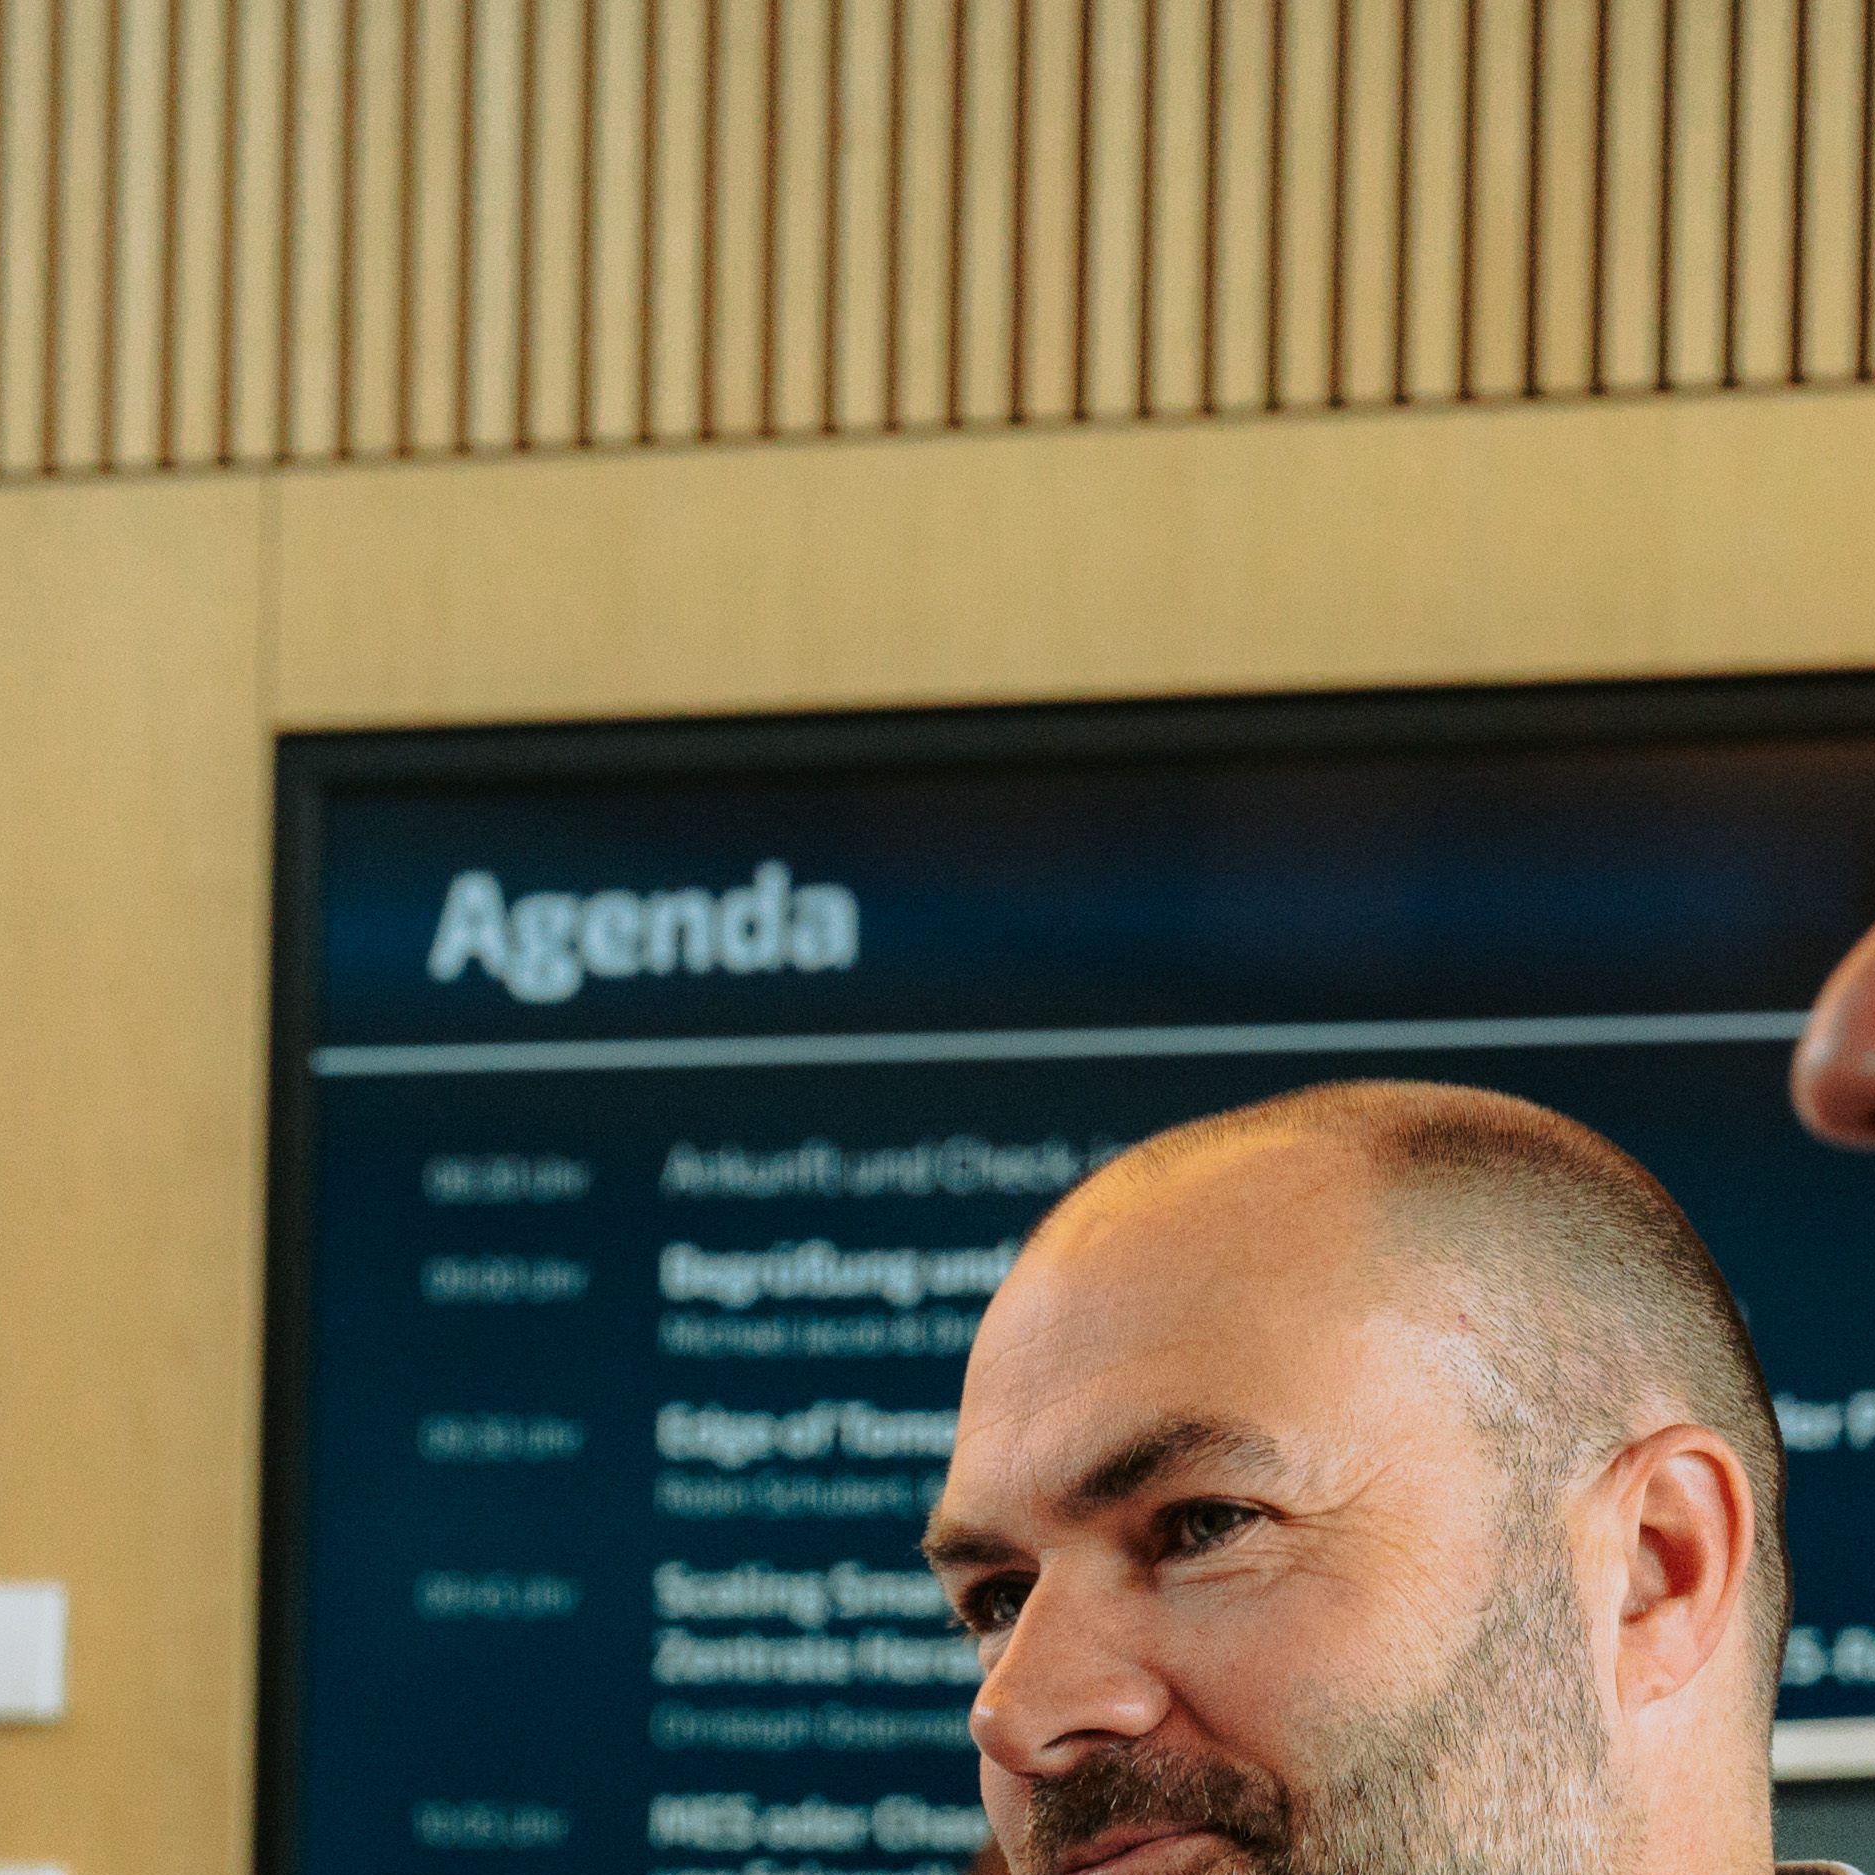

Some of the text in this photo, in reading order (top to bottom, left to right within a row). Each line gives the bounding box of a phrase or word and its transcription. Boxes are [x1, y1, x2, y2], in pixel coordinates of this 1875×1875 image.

[428, 860, 860, 1003] Agenda
[662, 1139, 838, 1192] Ankunft
[845, 1141, 934, 1190] und
[660, 1241, 917, 1305] Begrüßung
[658, 1402, 961, 1470] Edge of Tomo
[653, 1562, 941, 1625] Scaling Sma
[856, 1629, 983, 1684] Hera
[650, 1796, 758, 1851] MES
[762, 1796, 870, 1852] oder
